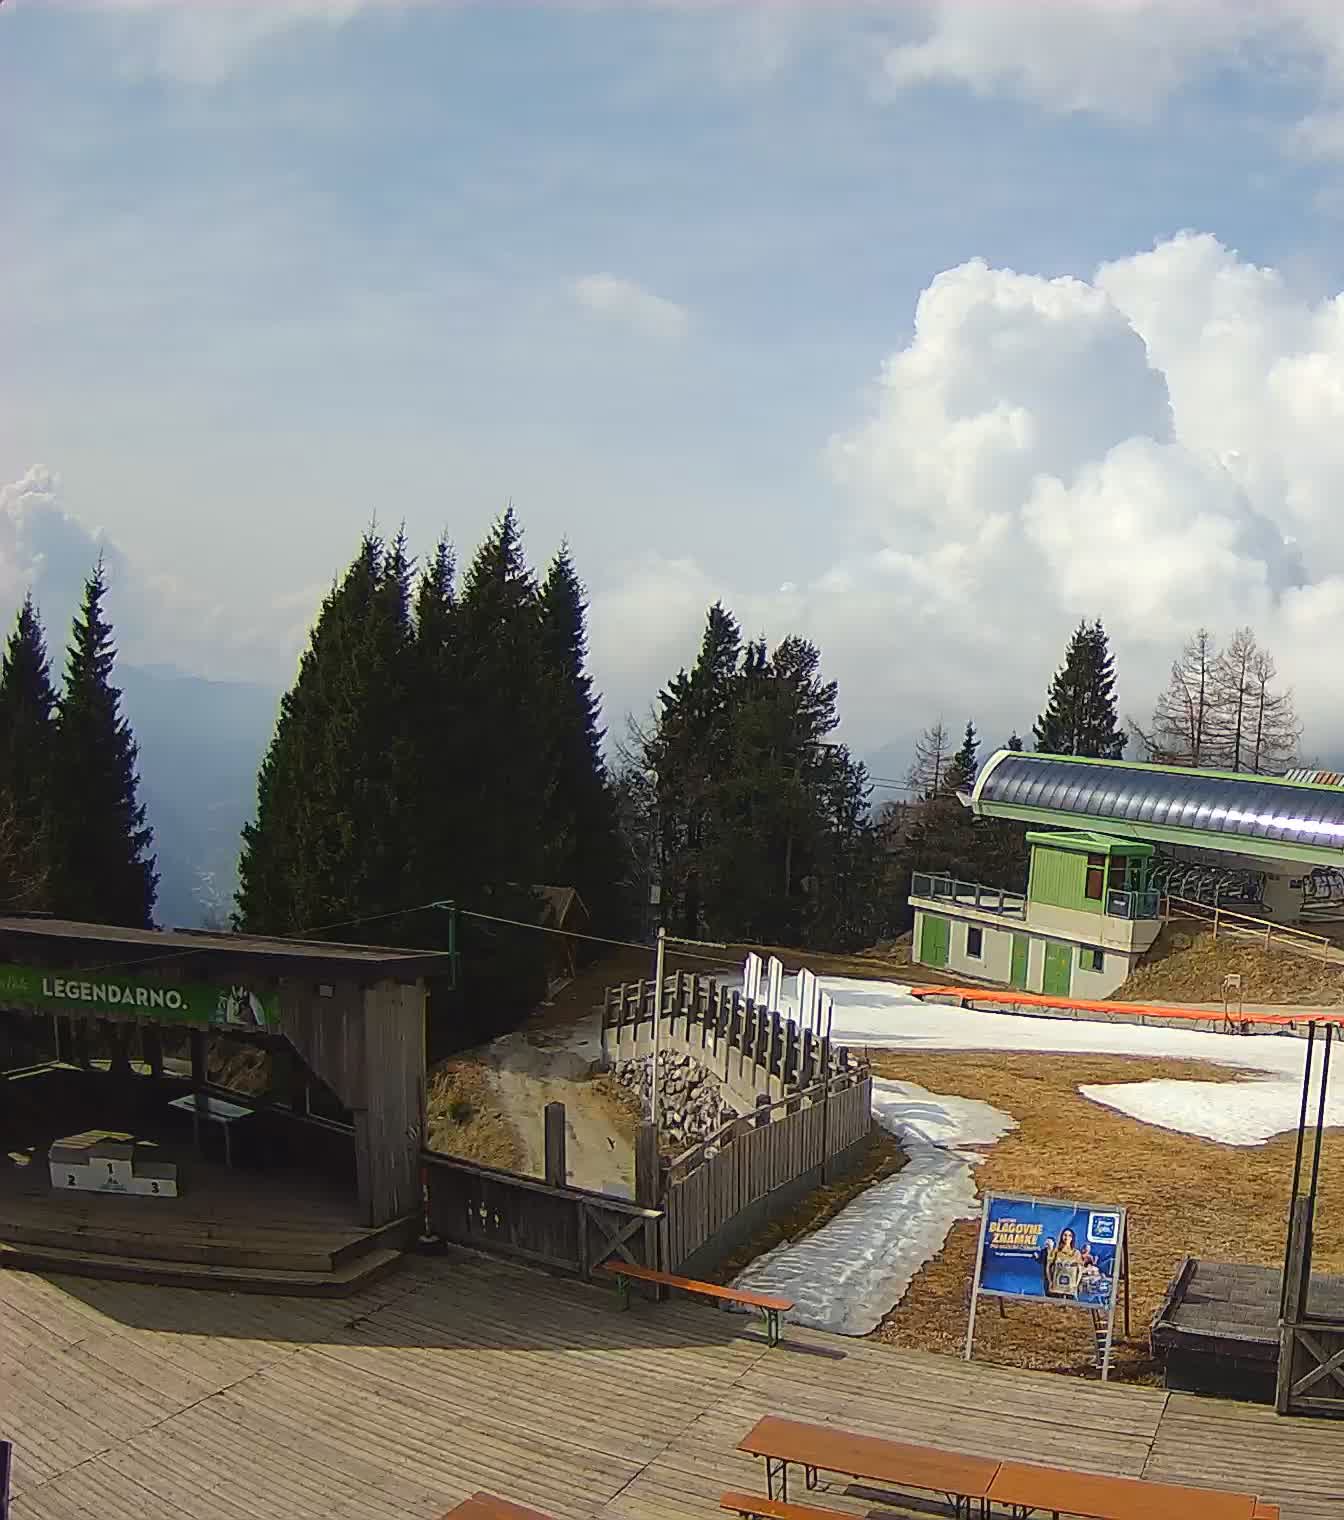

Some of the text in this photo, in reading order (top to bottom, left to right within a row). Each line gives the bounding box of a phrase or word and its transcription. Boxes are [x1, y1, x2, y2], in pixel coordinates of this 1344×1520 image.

[42, 977, 189, 1010] LEGENDARNO.
[106, 1162, 114, 1175] 1
[67, 1174, 76, 1186] 2
[151, 1181, 160, 1194] 3
